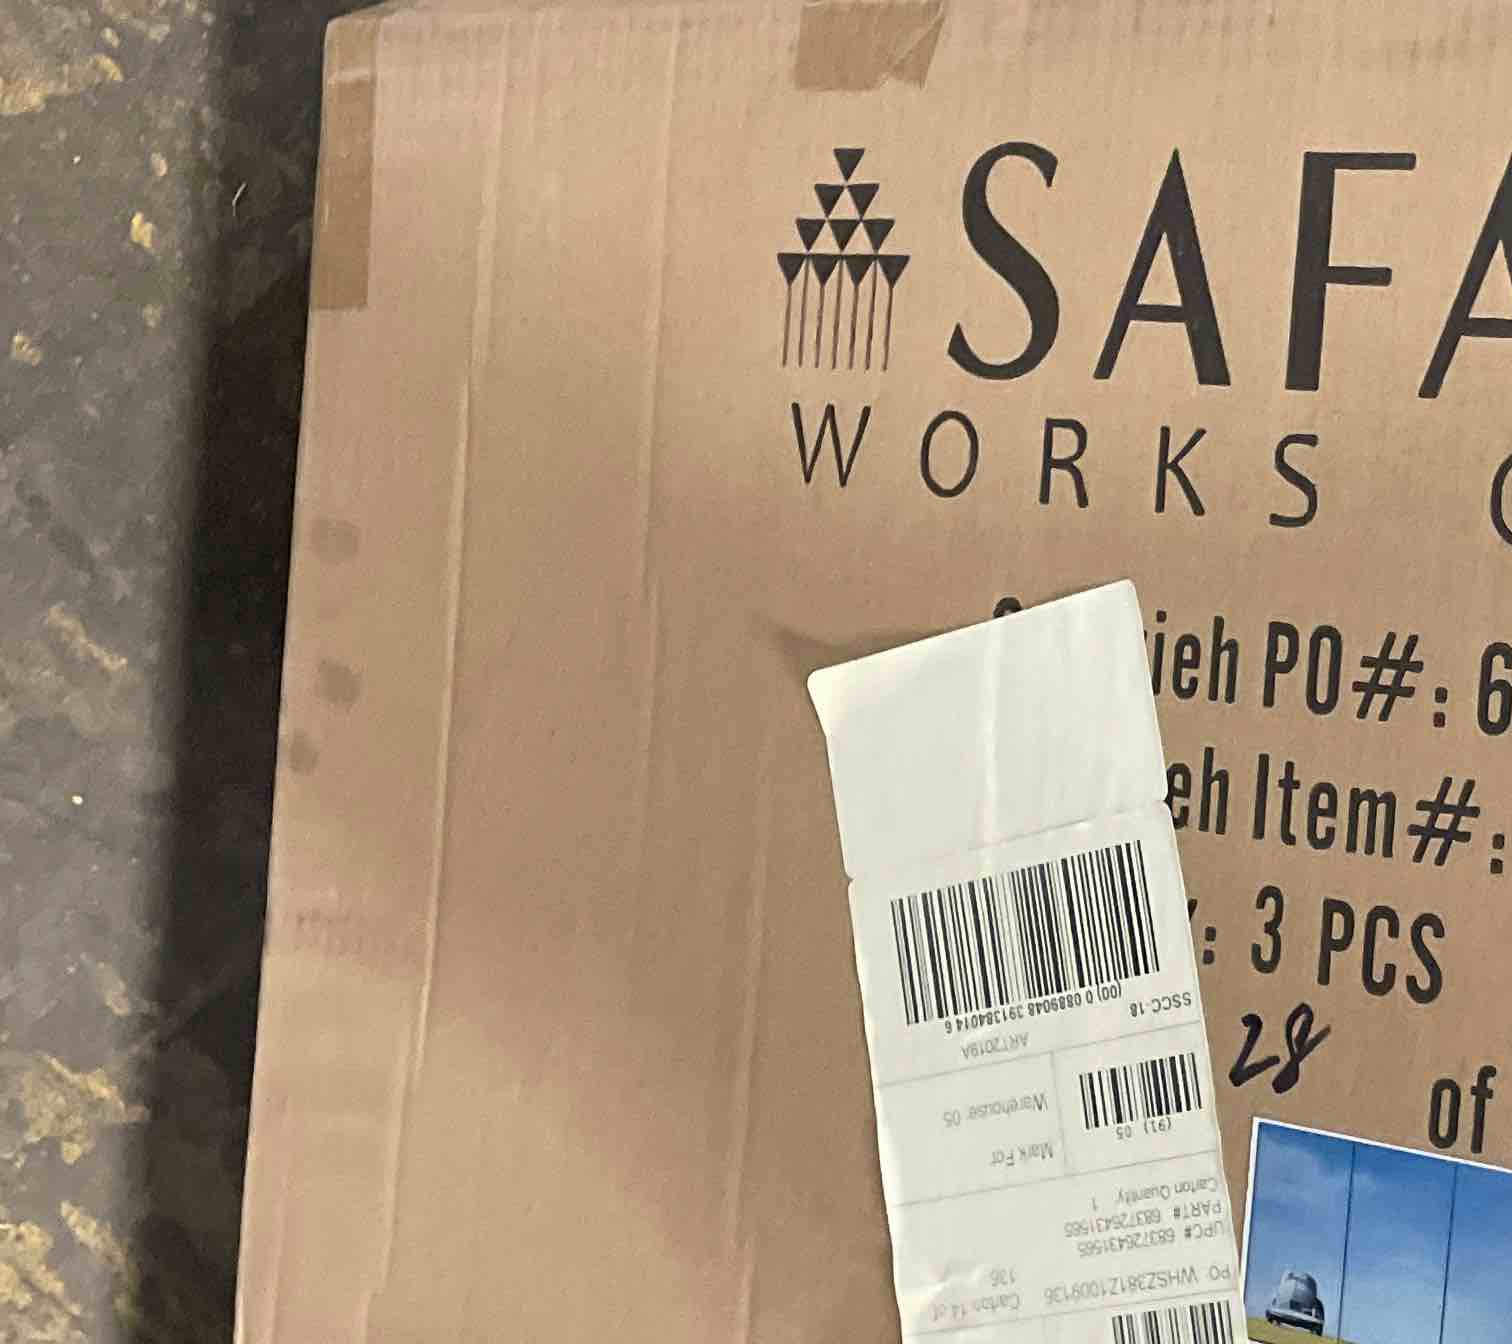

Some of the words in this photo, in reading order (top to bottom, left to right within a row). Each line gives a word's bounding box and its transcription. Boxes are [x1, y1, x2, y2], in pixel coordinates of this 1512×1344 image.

[790, 401, 1322, 530] WORKS
[1252, 751, 1506, 876] Item#:
[1250, 885, 1283, 973] 3
[1317, 897, 1448, 1006] PCS
[1084, 989, 1093, 1003] 0
[1096, 981, 1122, 1000] (00)
[1026, 992, 1082, 1017] 0889048
[944, 1019, 953, 1034] 6
[1427, 1063, 1496, 1151] of
[1115, 1125, 1133, 1139] 05
[1143, 1116, 1172, 1135] (91)
[1018, 1142, 1054, 1160] Mark
[1174, 1177, 1218, 1195] Carton
